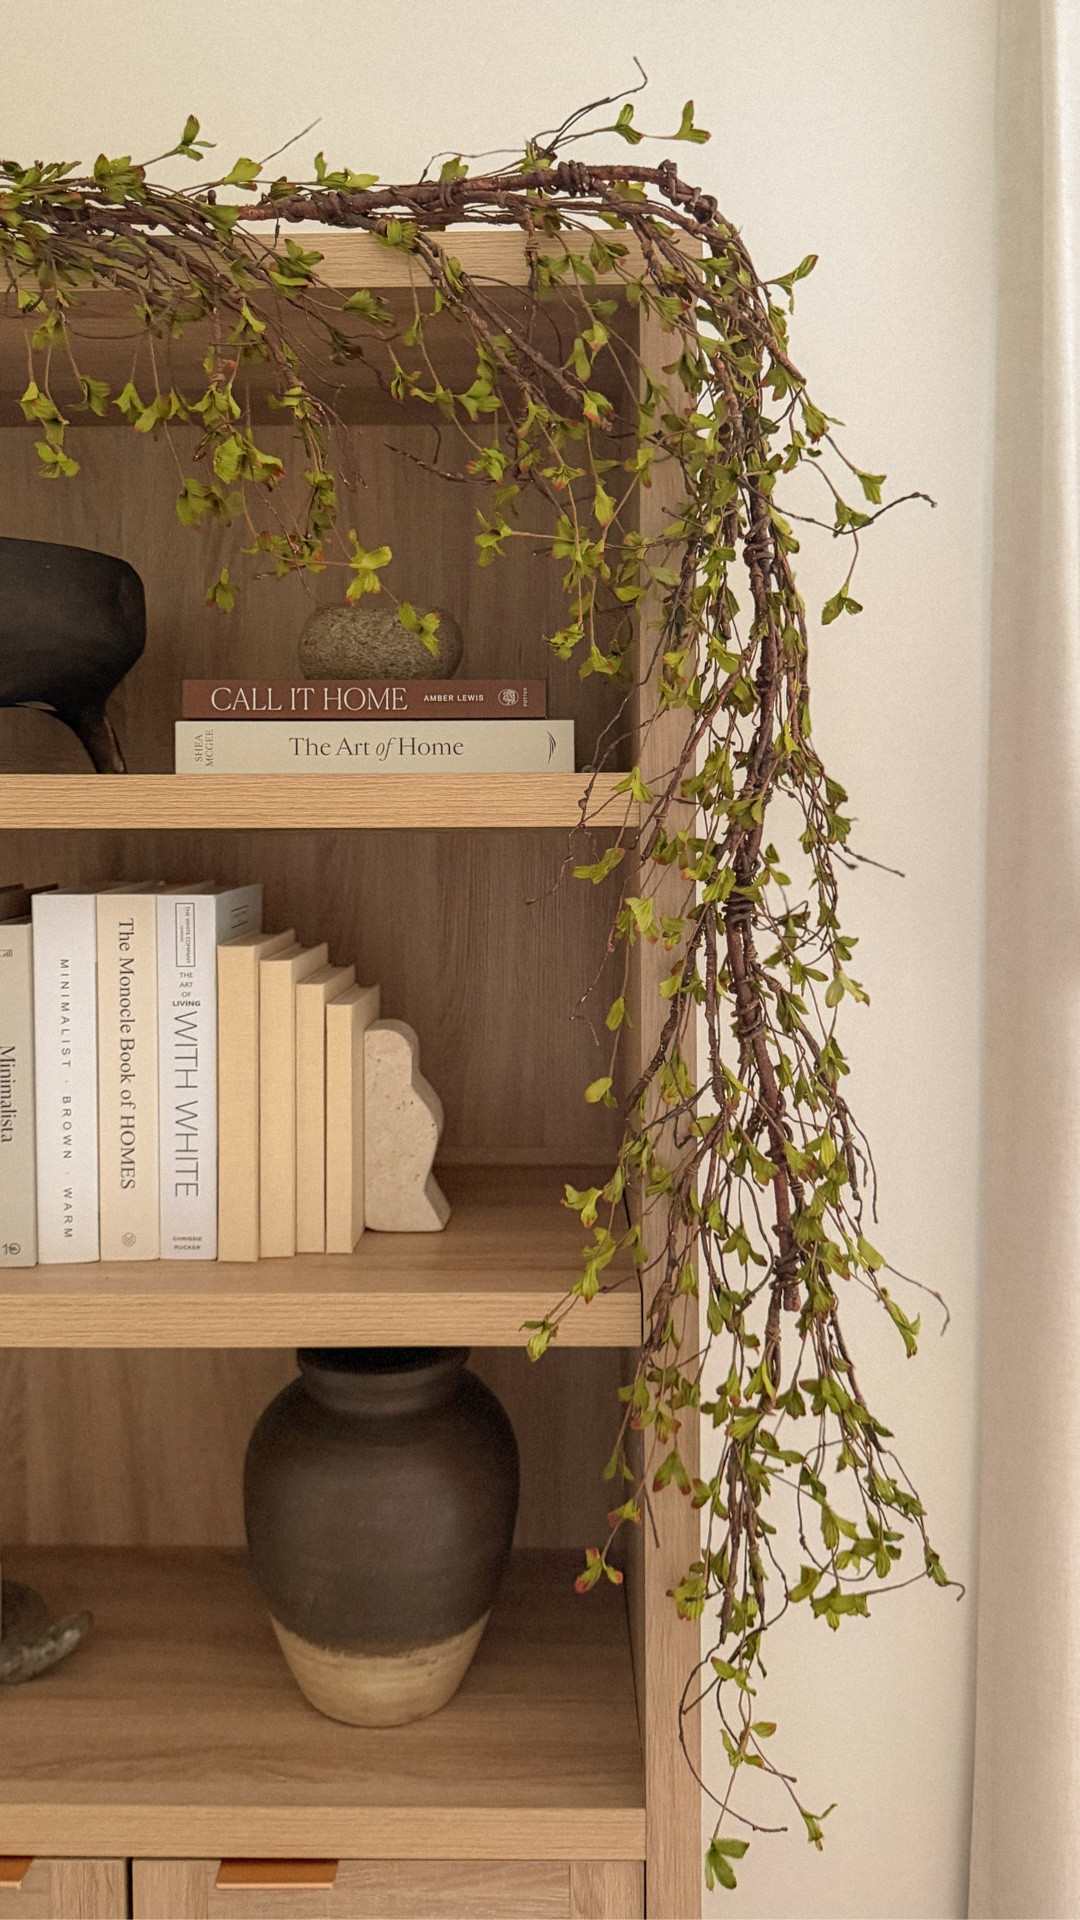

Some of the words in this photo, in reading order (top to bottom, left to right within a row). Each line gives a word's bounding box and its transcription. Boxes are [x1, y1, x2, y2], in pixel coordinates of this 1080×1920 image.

[210, 687, 283, 711] CALL
[290, 687, 315, 711] IT
[323, 687, 408, 711] HOME
[423, 694, 454, 702] AMBER
[457, 694, 484, 702] LEWIS
[194, 734, 203, 762] SHEA
[205, 729, 214, 767] MCGEE
[289, 737, 331, 756] The
[335, 737, 370, 756] Art
[376, 737, 396, 762] of
[398, 737, 464, 756] Home
[119, 917, 135, 951] The
[60, 959, 71, 1067] MINIMALIST
[119, 957, 136, 1034] Monocle
[120, 1038, 136, 1084] Book
[174, 1010, 198, 1088] WITH
[0, 1046, 17, 1143] Minimalista
[120, 1089, 136, 1111] of
[62, 1096, 73, 1159] BROWN
[175, 1100, 199, 1197] WHITE
[120, 1115, 136, 1189] HOMES
[63, 1187, 73, 1238] WARM
